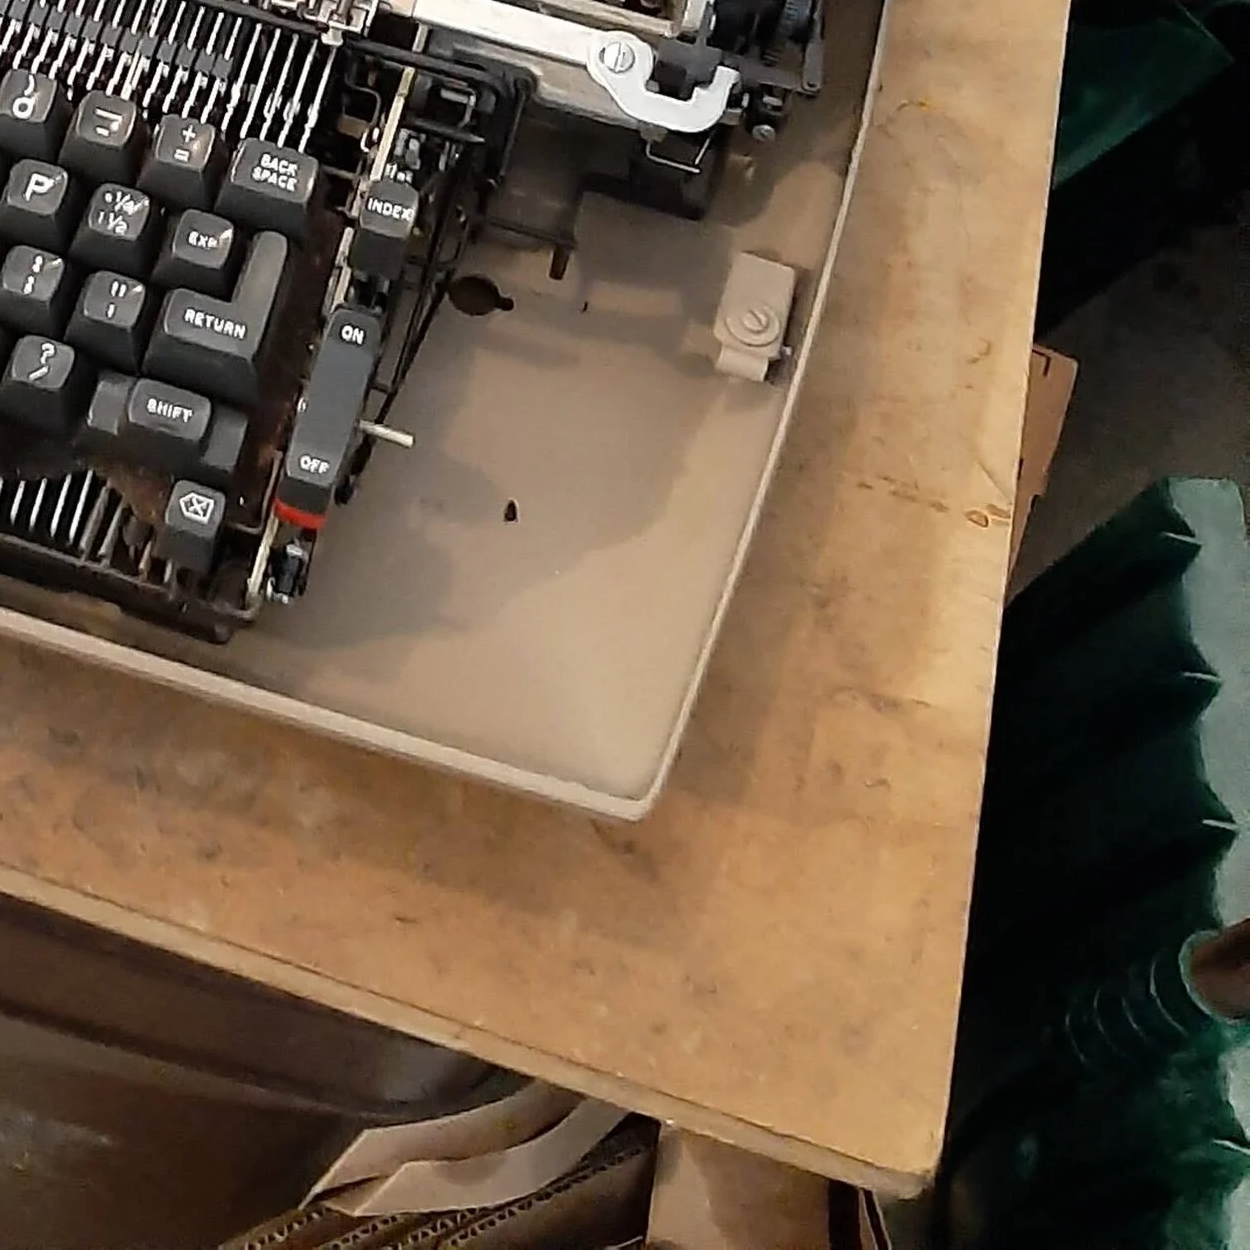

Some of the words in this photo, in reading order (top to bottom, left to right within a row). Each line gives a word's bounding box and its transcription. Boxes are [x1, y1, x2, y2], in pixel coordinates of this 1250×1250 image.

[260, 153, 298, 177] BACK
[23, 172, 52, 201] P
[251, 166, 298, 192] SPACE
[368, 197, 415, 222] INDEX
[184, 308, 246, 339] RETURN
[341, 324, 365, 347] ON
[146, 398, 194, 424] SHIFT
[300, 454, 330, 476] OFF
